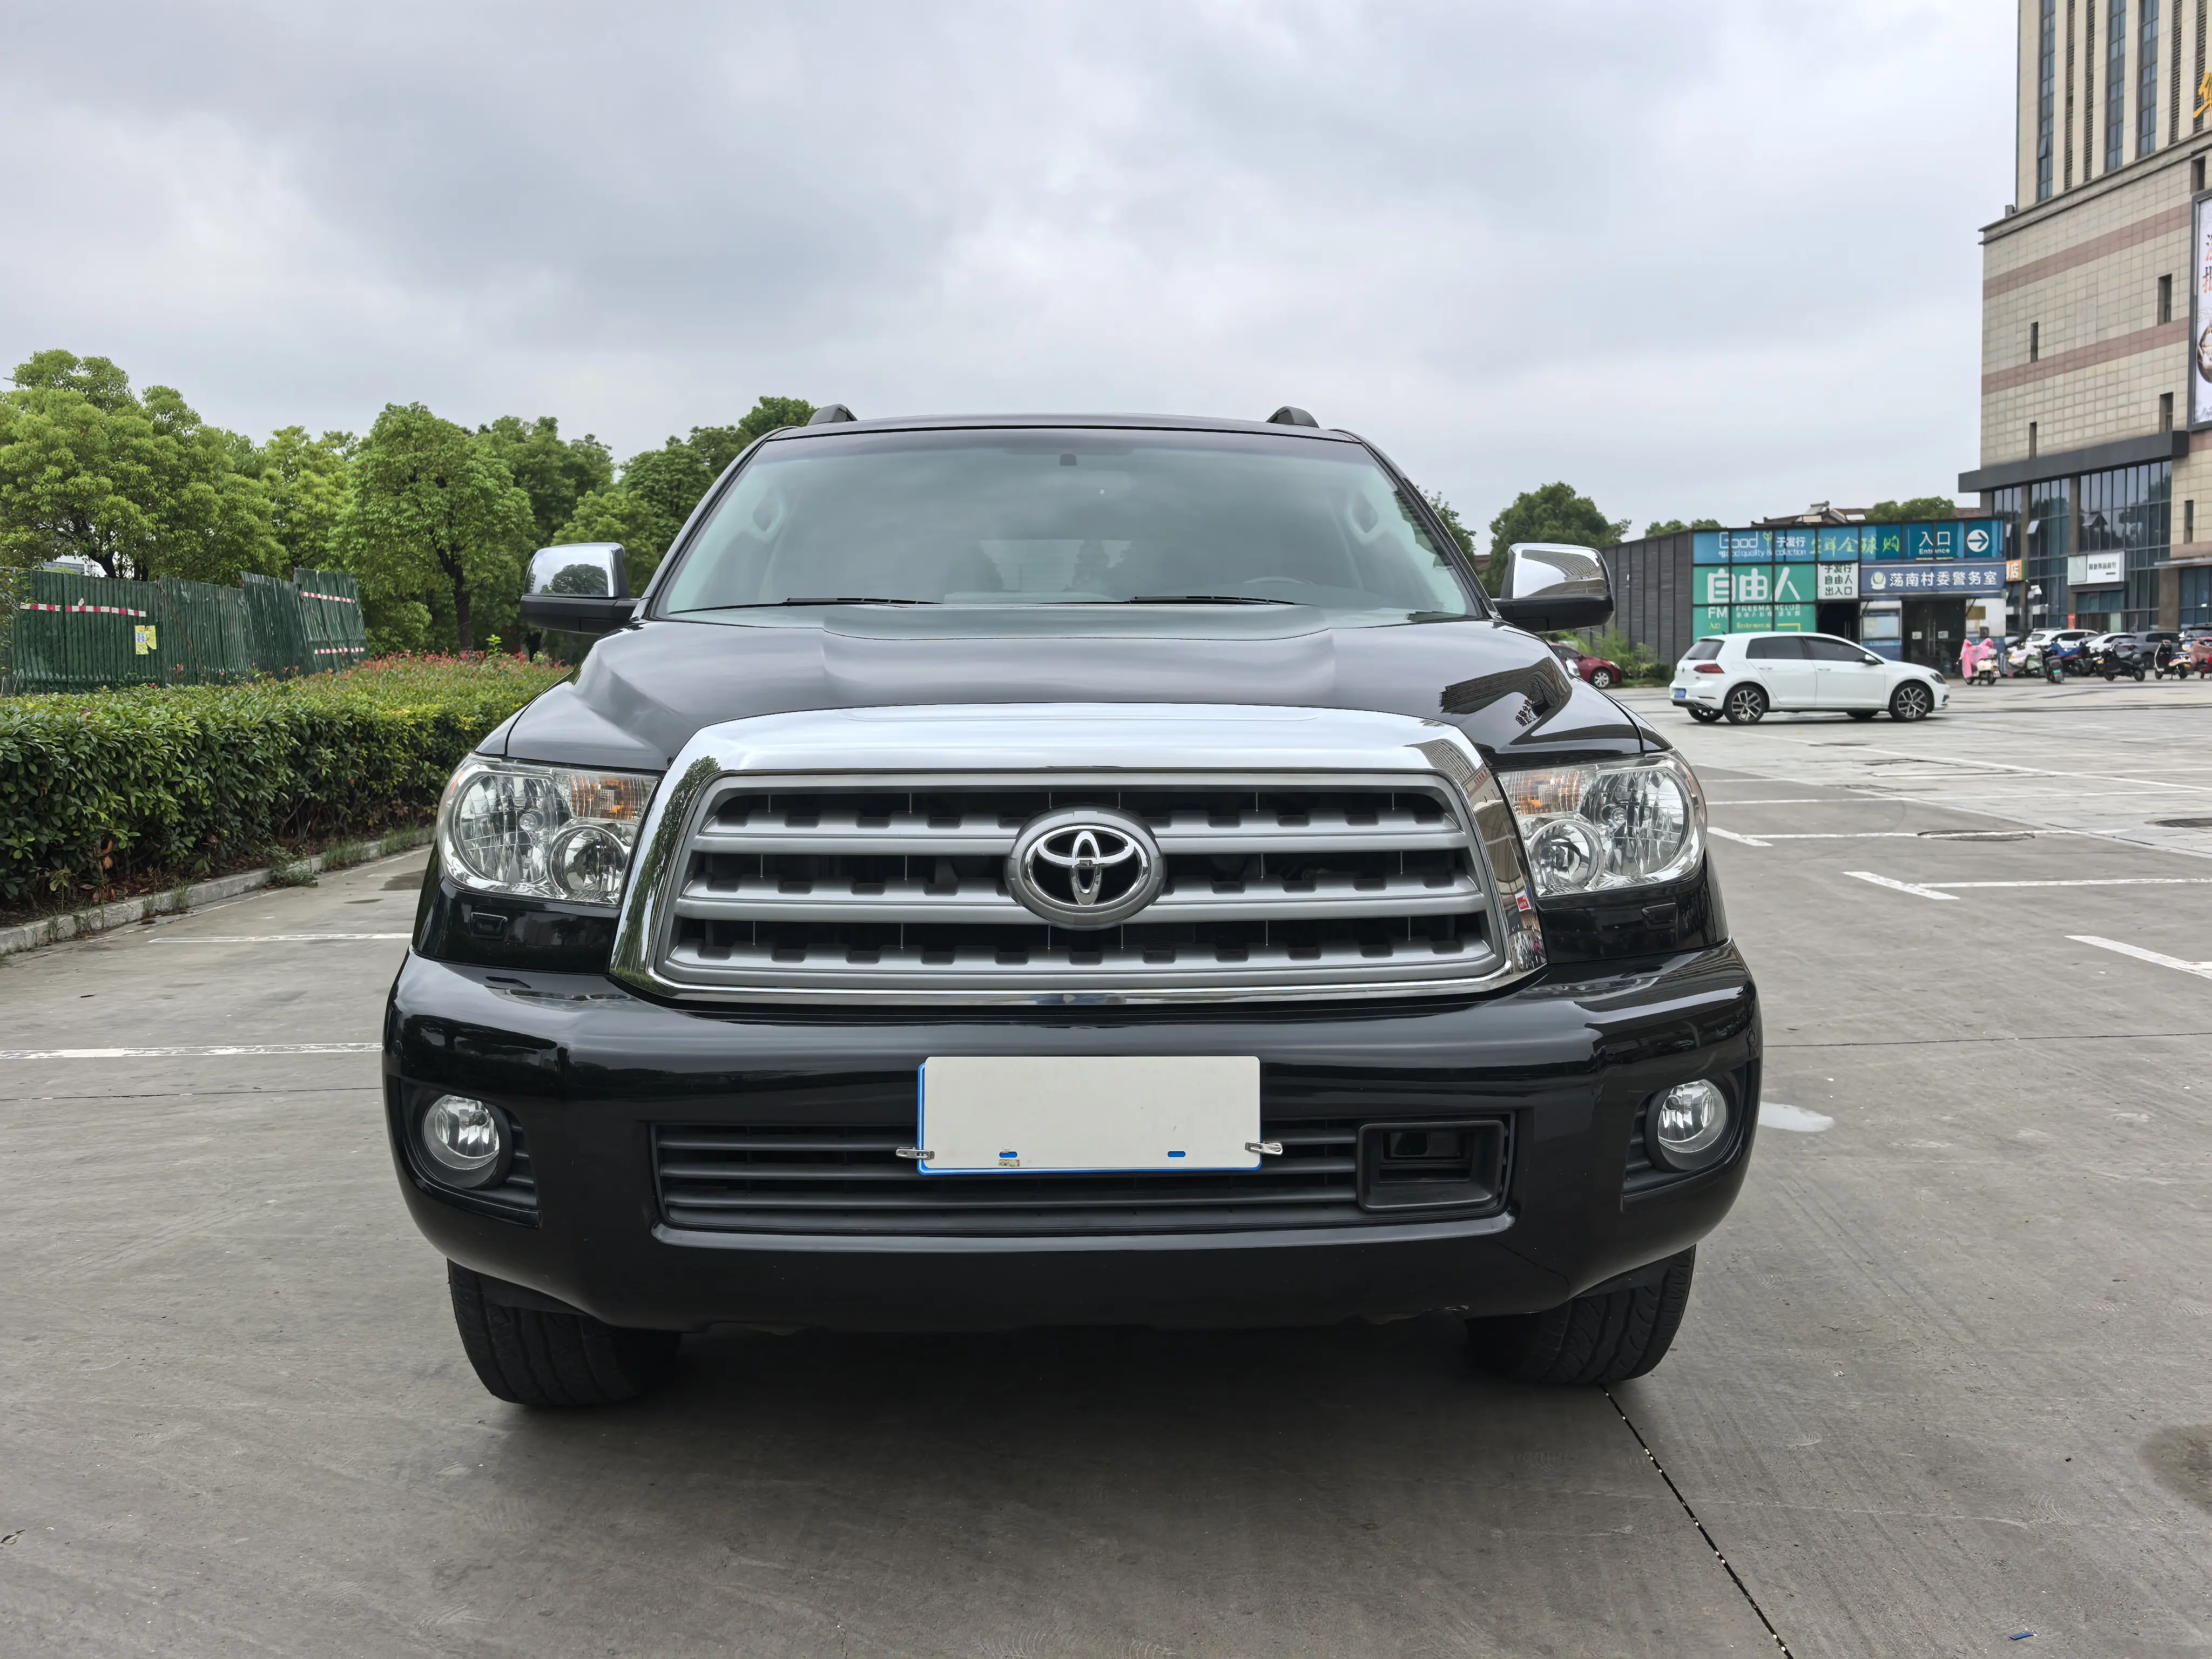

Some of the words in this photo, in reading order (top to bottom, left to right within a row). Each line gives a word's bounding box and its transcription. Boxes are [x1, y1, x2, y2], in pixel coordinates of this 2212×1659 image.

[1919, 531, 1951, 547] 入口
[1707, 567, 1800, 604] 自由人
[1824, 575, 1853, 585] 自由人
[1825, 586, 1852, 596] 出入口
[1708, 606, 1728, 619] FM
